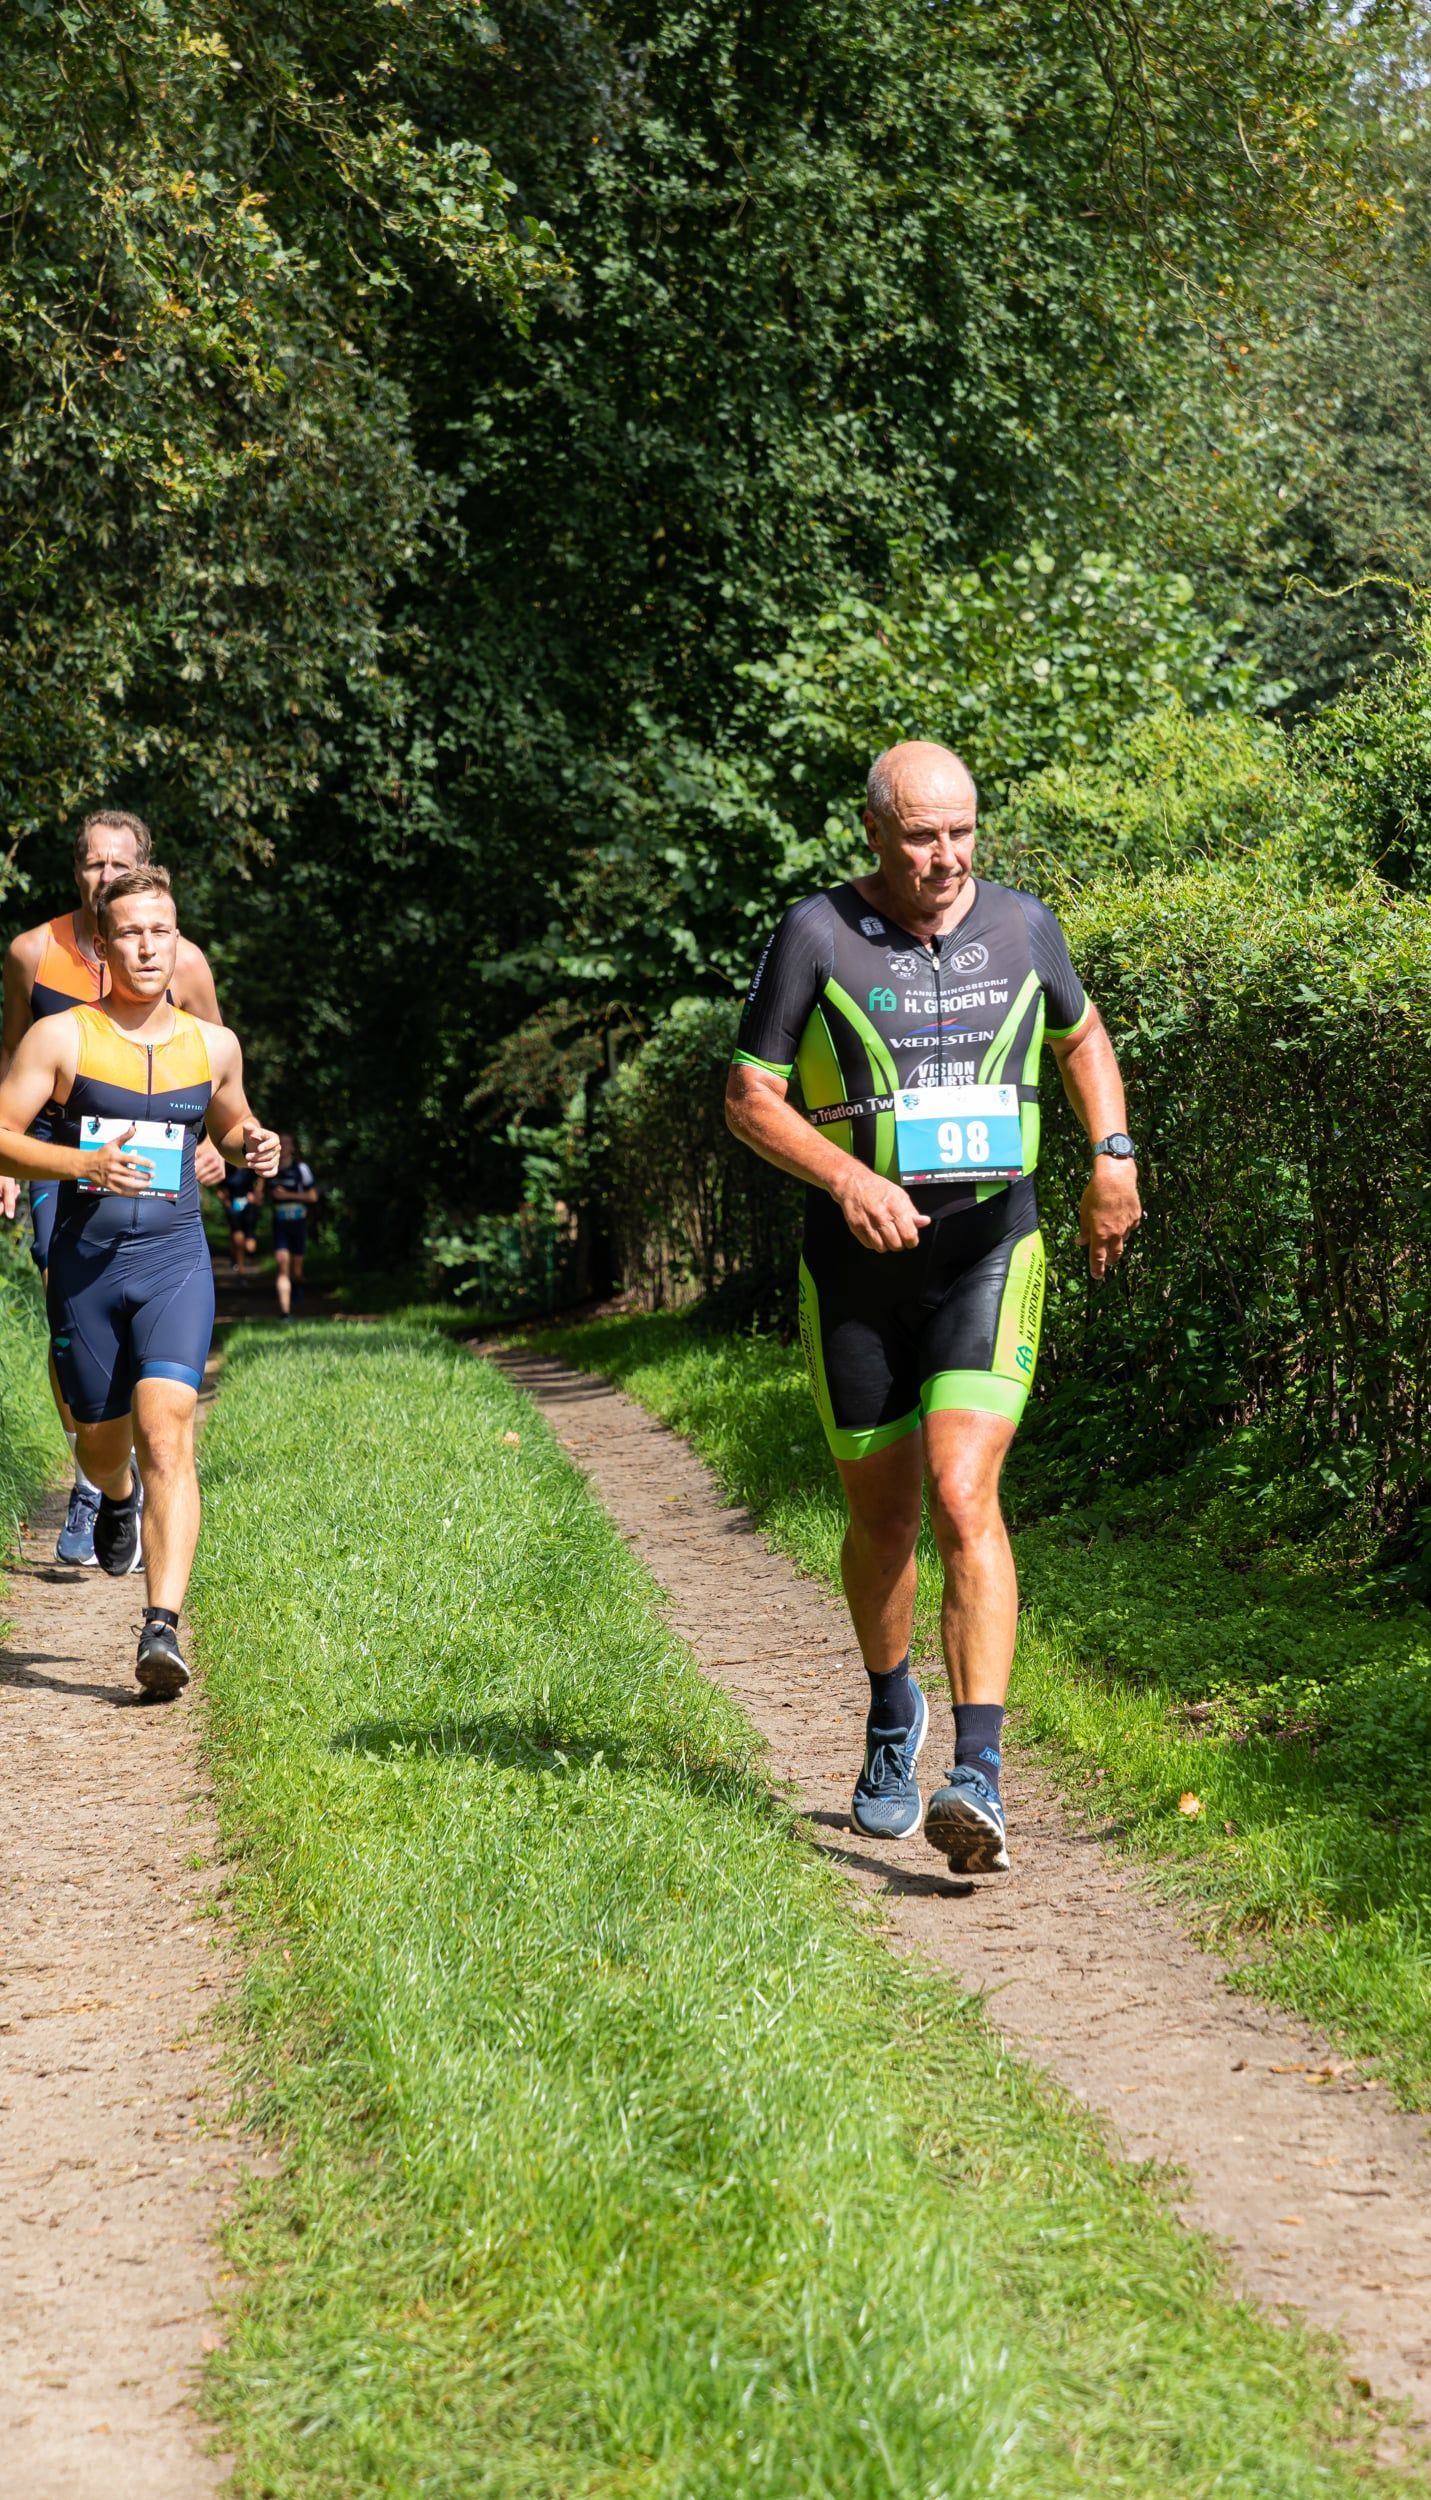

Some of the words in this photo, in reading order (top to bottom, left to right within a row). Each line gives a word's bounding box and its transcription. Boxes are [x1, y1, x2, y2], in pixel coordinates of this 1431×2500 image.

[954, 947, 983, 970] RW
[905, 978, 1009, 998] AANNEMINGSBEDRIJF
[904, 998, 922, 1014] H.
[923, 992, 986, 1015] GROEN
[989, 989, 1009, 1005] bv
[889, 1030, 995, 1049] VREDESTEIN
[918, 1060, 976, 1079] VISION
[917, 1075, 975, 1089] SPORTS
[817, 1103, 864, 1123] Triatlon
[937, 1120, 990, 1164] 98
[1027, 1278, 1042, 1329] GROEN
